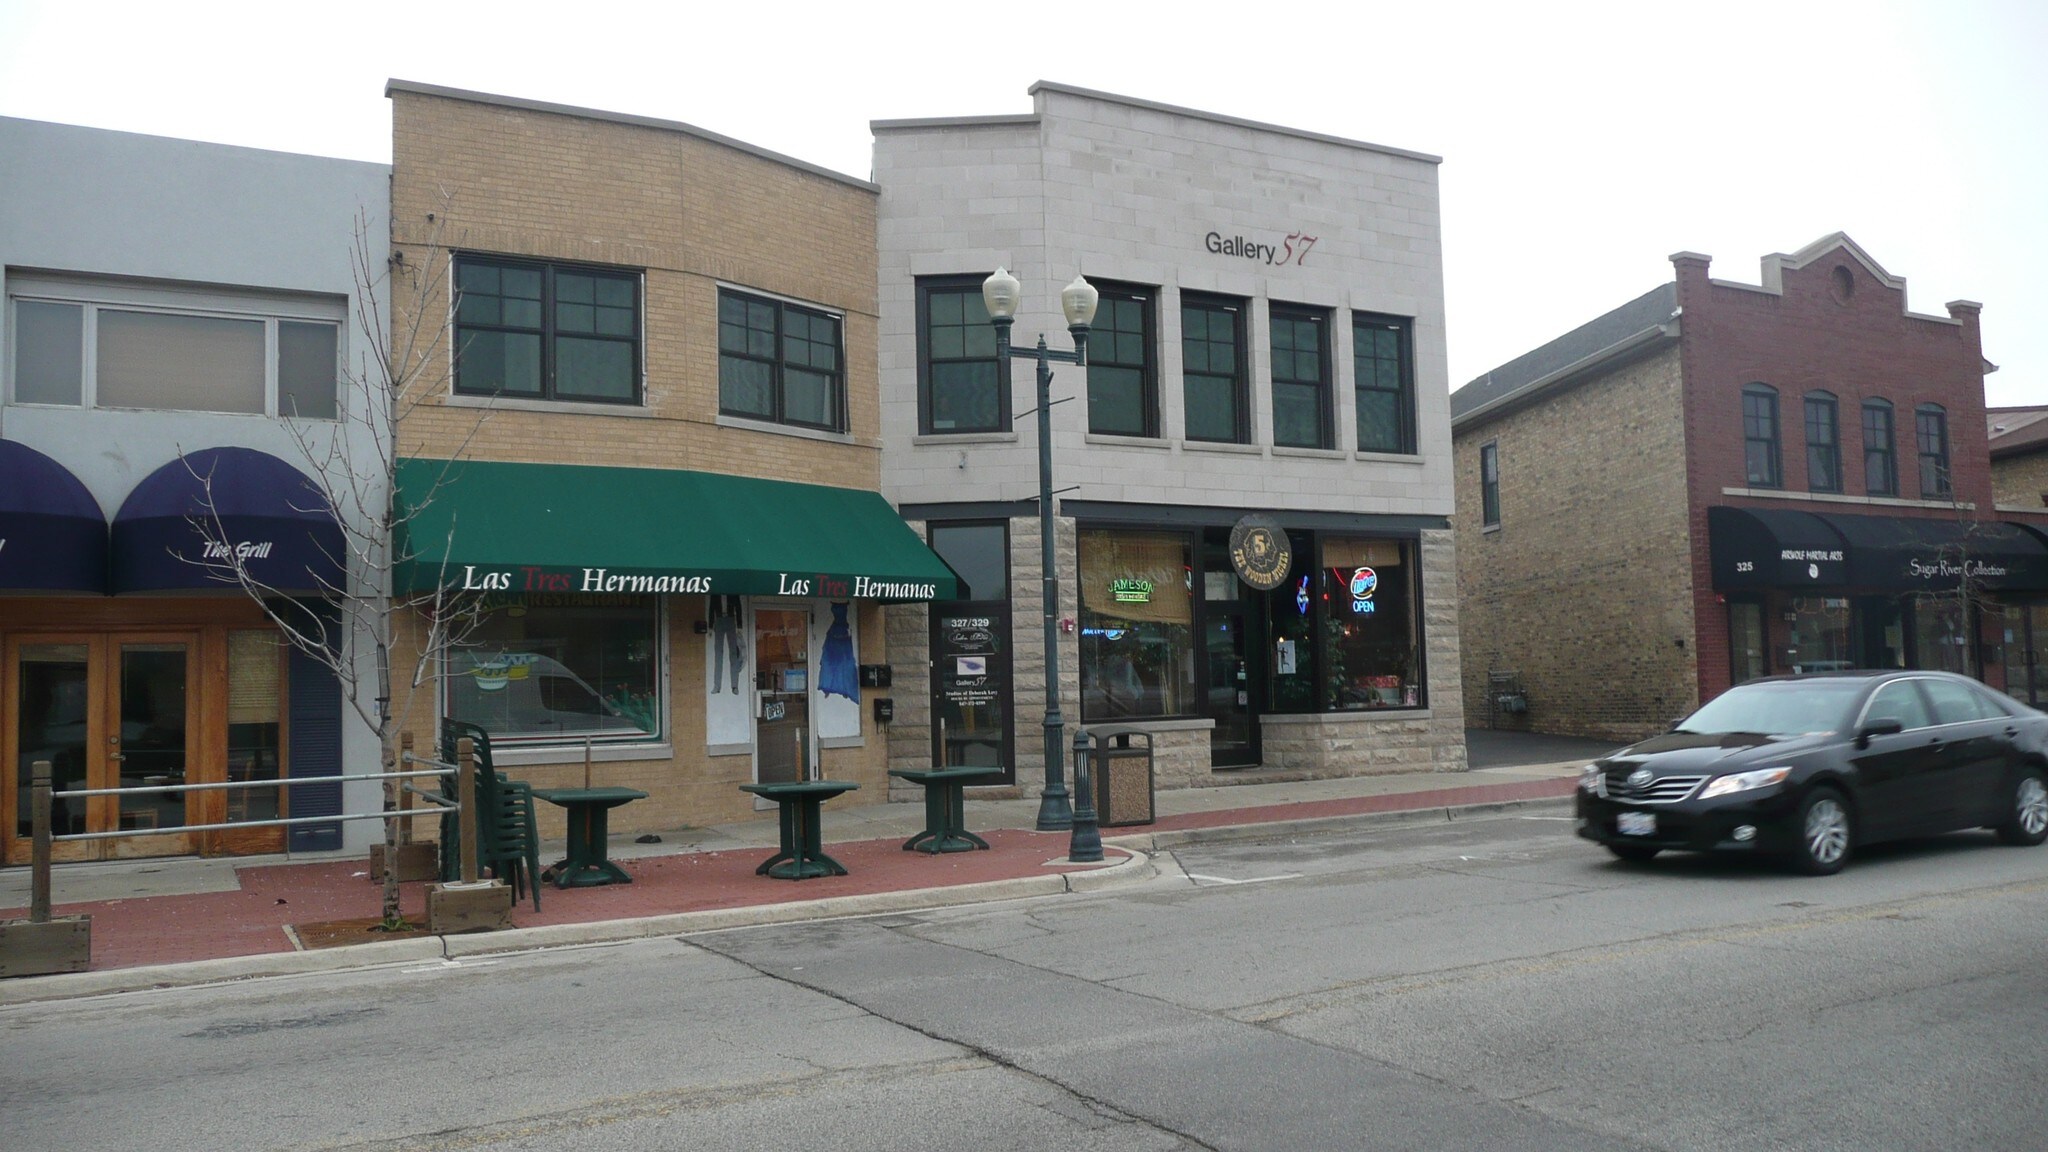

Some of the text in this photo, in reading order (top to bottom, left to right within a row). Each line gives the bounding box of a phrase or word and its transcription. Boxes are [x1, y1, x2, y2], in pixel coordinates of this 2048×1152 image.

[1205, 230, 1318, 266] Gallery 57
[203, 541, 273, 559] The Grill
[1254, 534, 1267, 557] 5
[1806, 550, 1829, 561] MARTIAL
[1829, 551, 1843, 561] ARTS
[1233, 548, 1289, 585] THE WOODEN NICKEL
[1736, 562, 1753, 572] 325
[1910, 558, 2006, 579] Sugar River Collection
[462, 566, 712, 593] Las Tres Hermanas
[778, 573, 936, 599] Las Tres Hermanas
[1108, 579, 1155, 593] JAMESON
[1352, 600, 1375, 613] OPEN
[951, 619, 989, 628] 327/329
[975, 676, 987, 687] 57
[768, 703, 784, 719] OPEN
